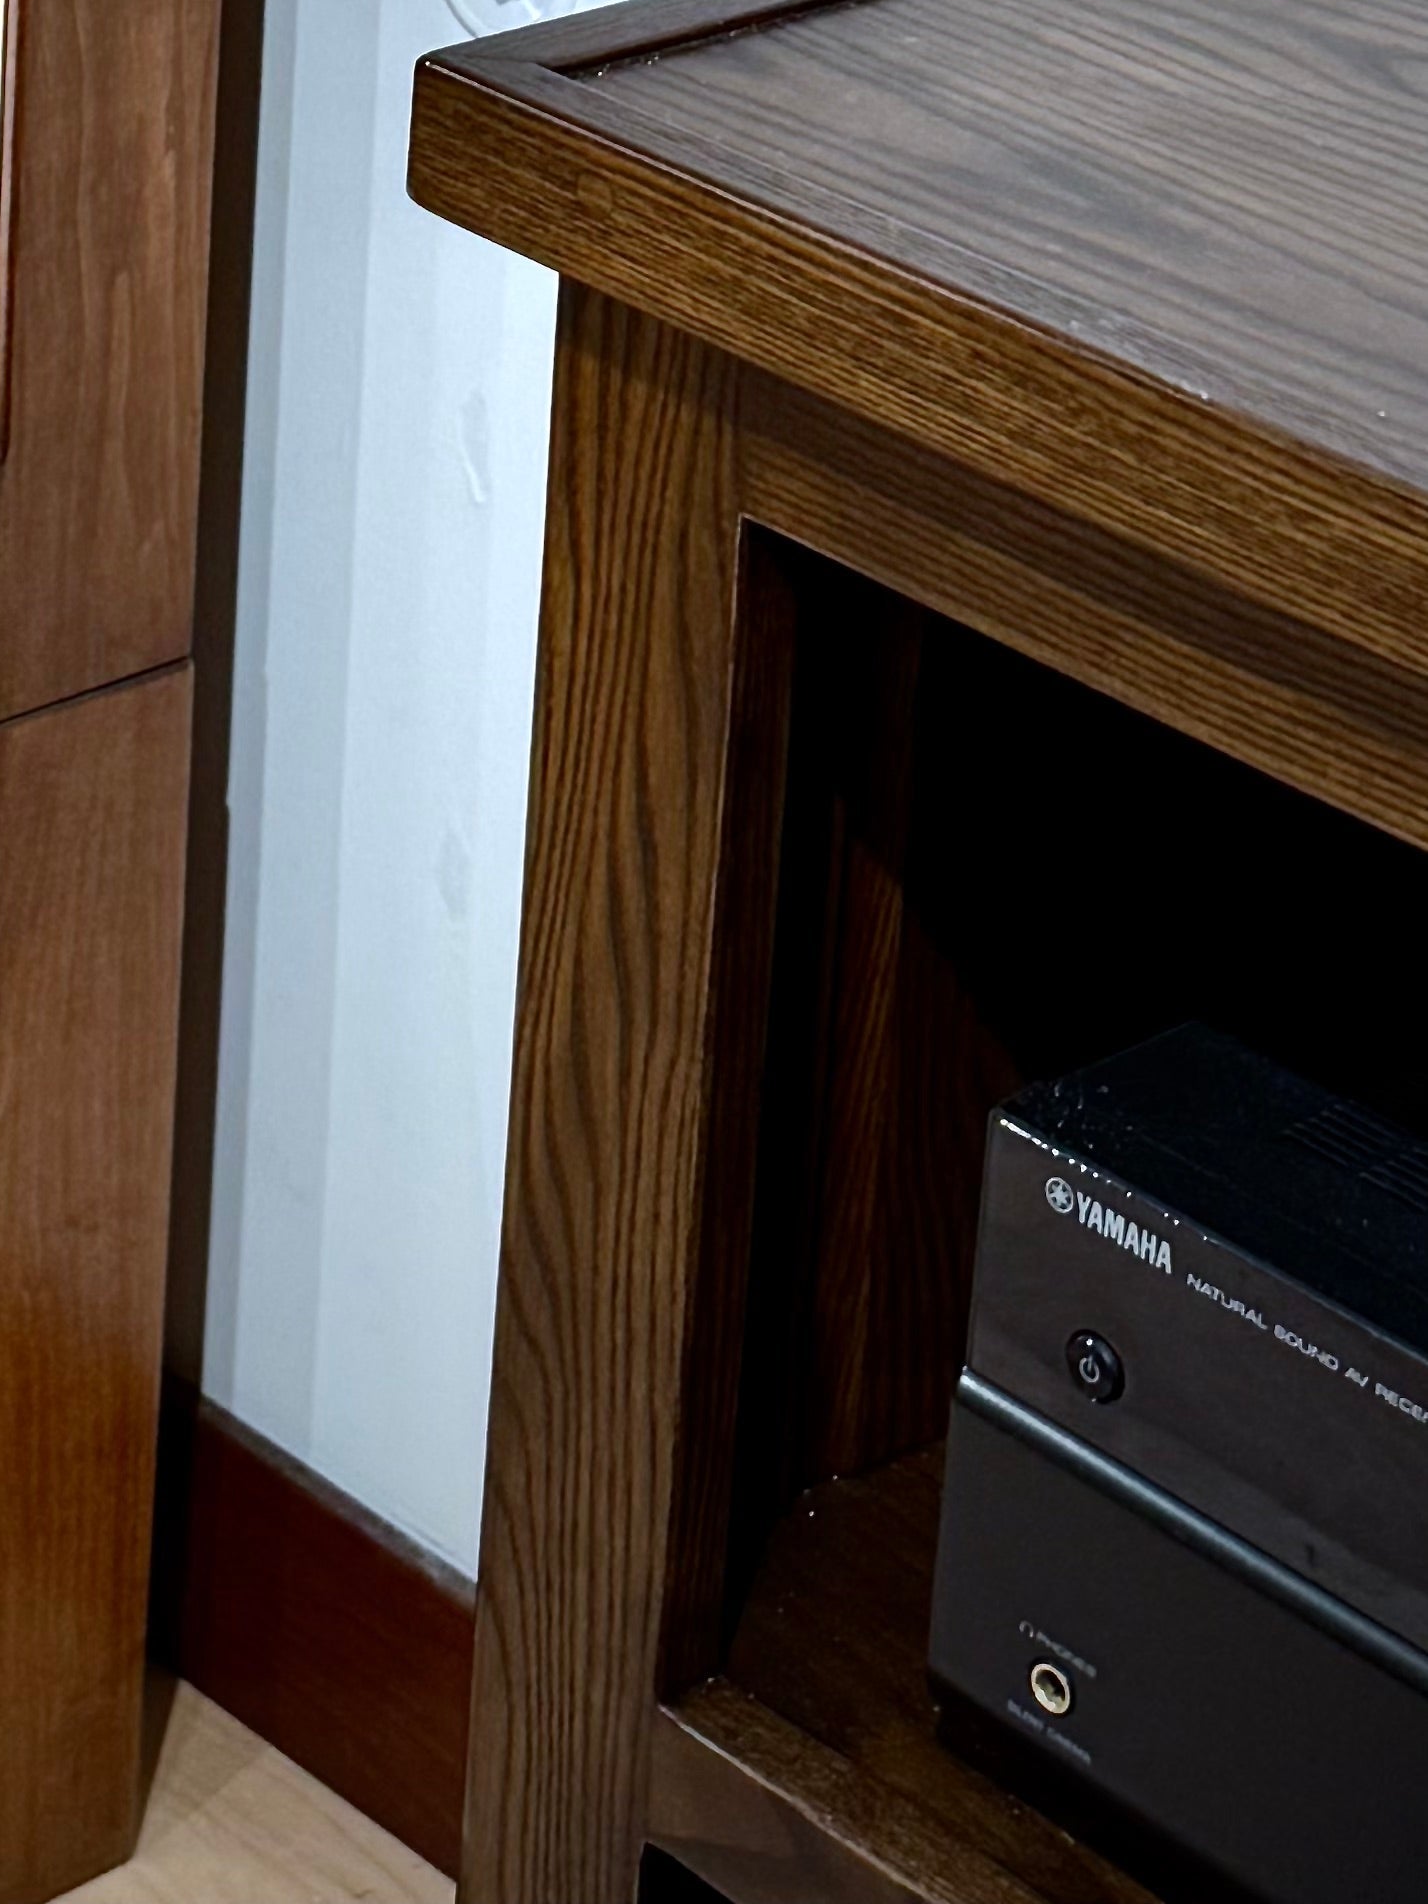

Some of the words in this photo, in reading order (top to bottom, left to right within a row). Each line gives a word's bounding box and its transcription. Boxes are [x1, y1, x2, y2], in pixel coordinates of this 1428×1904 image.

[1076, 1191, 1173, 1275] YAMAHA
[1186, 1273, 1268, 1330] NATURAL
[1274, 1324, 1339, 1371] SOUND
[1345, 1367, 1368, 1387] AV
